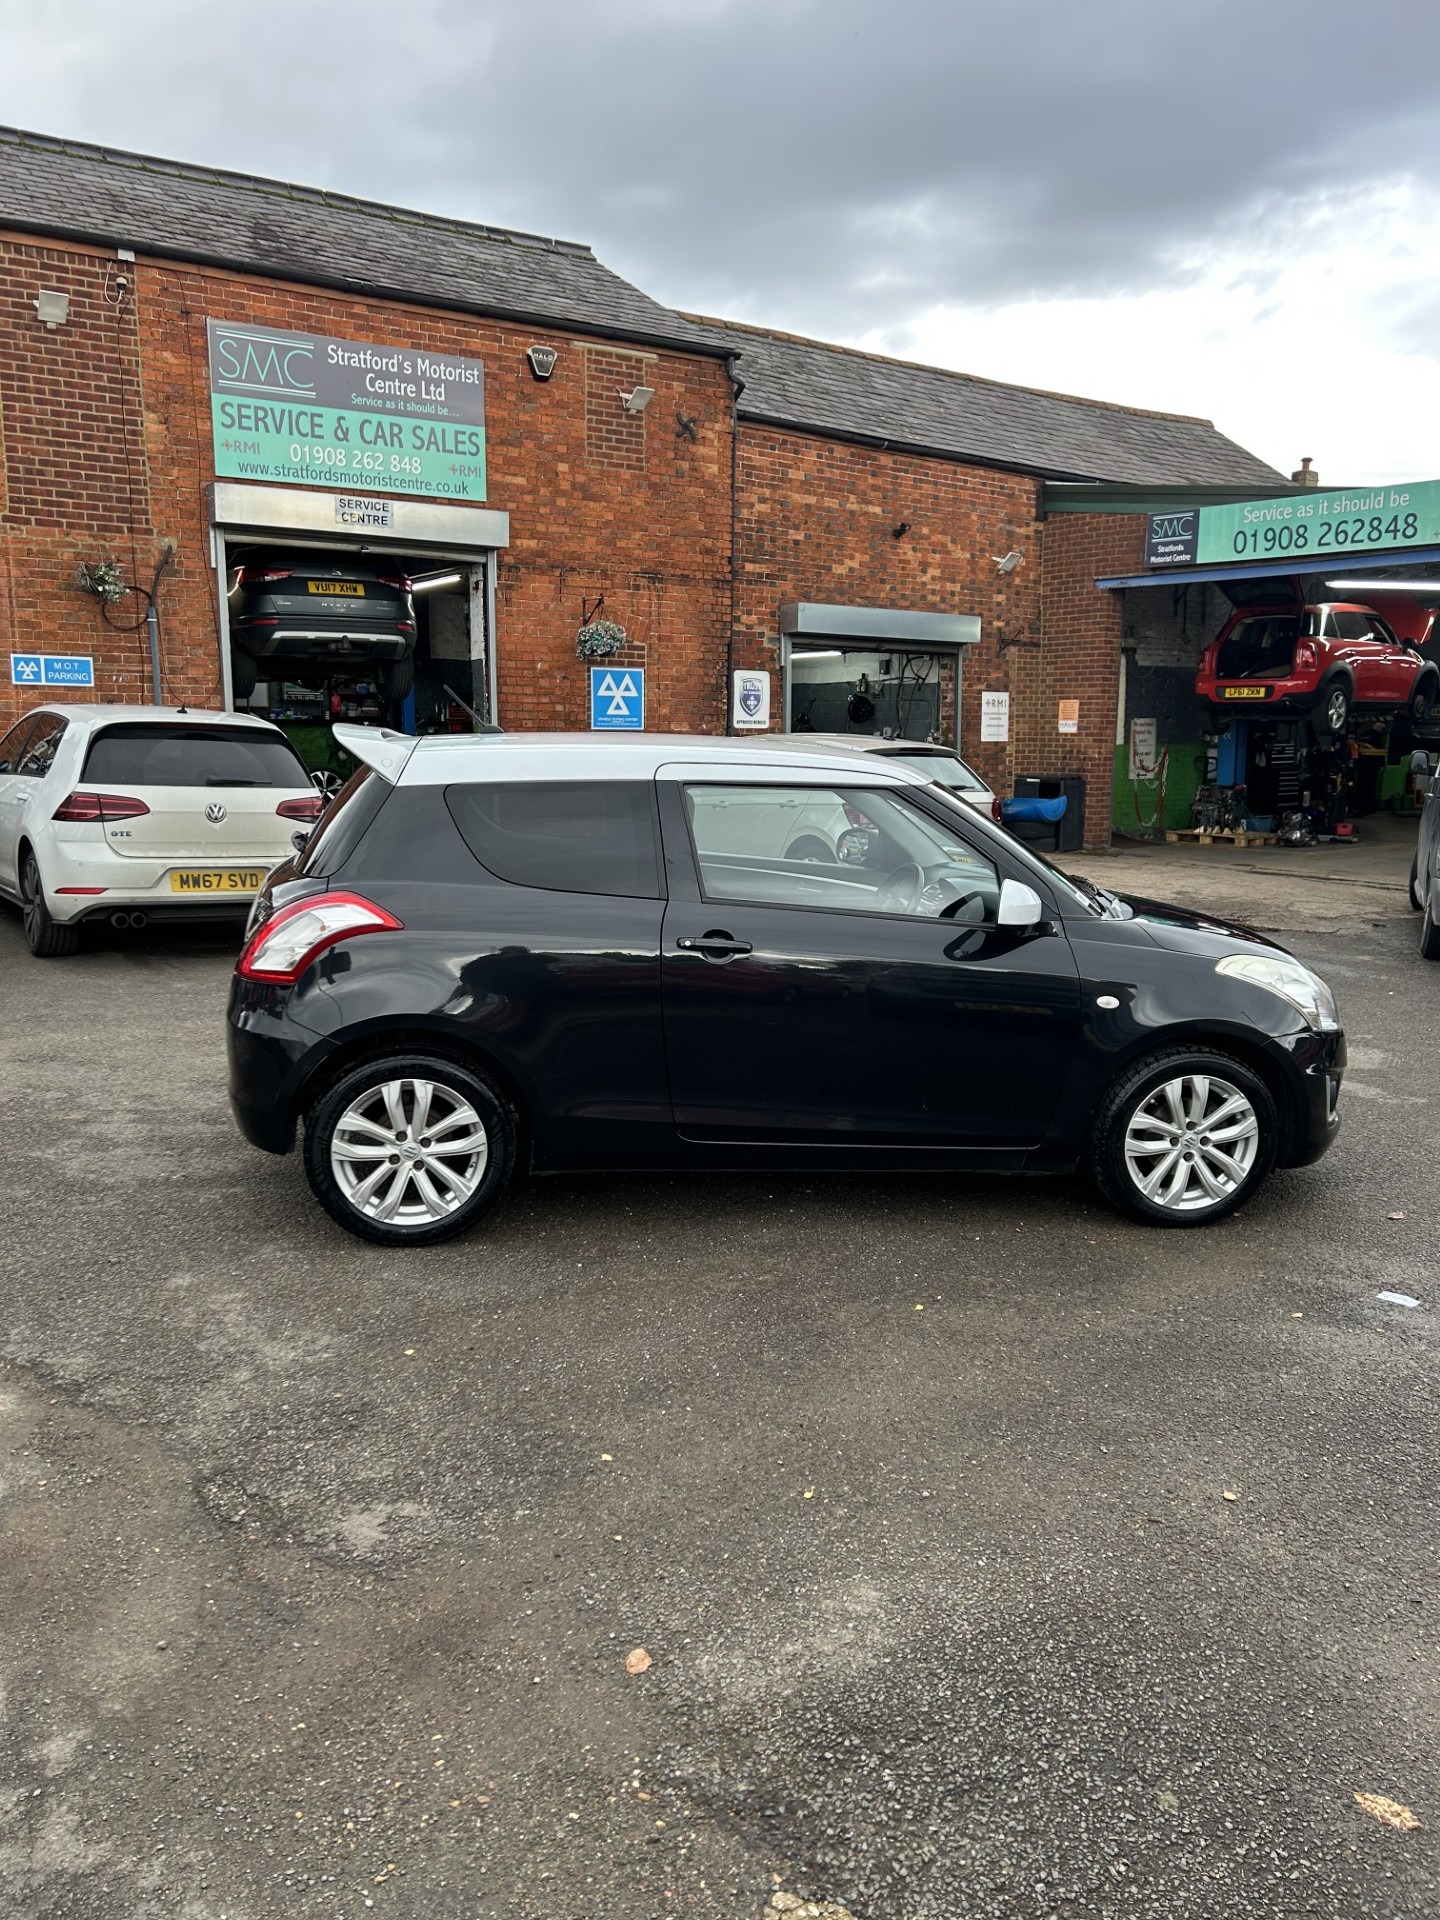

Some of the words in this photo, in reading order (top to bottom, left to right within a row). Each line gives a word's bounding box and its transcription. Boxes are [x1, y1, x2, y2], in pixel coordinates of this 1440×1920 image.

[218, 338, 315, 389] SMC
[327, 344, 413, 375] Stratford's
[417, 357, 480, 385] Motorist
[365, 372, 417, 398] Centre
[421, 380, 446, 402] Ltd
[351, 392, 383, 408] Service
[385, 400, 396, 410] as
[397, 399, 405, 411] it
[406, 400, 436, 415] should
[220, 401, 325, 440] SERVICE
[333, 415, 350, 443] &
[358, 418, 404, 449] CAR
[411, 424, 481, 457] SALES
[290, 443, 347, 467] 01908
[352, 450, 385, 471] 262
[390, 454, 422, 475] 848
[237, 461, 470, 495] www.stratfordsmotoristcentre.co.uk
[338, 498, 390, 513] SERVICE
[1243, 504, 1293, 524] Service
[1296, 503, 1314, 518] as
[1318, 499, 1329, 515] it
[1332, 491, 1385, 514] should
[1389, 490, 1411, 508] be
[341, 511, 389, 526] CENTRE
[1151, 516, 1194, 539] SMC
[1233, 523, 1309, 555] 01908
[1317, 512, 1418, 547] 262848
[1150, 554, 1172, 564] Motorist
[1172, 553, 1192, 562] Centre
[314, 582, 337, 593] VU17
[48, 671, 89, 681] PARKING
[53, 661, 82, 671] M.O.T.
[179, 873, 223, 889] MW67
[228, 873, 259, 888] SVD
